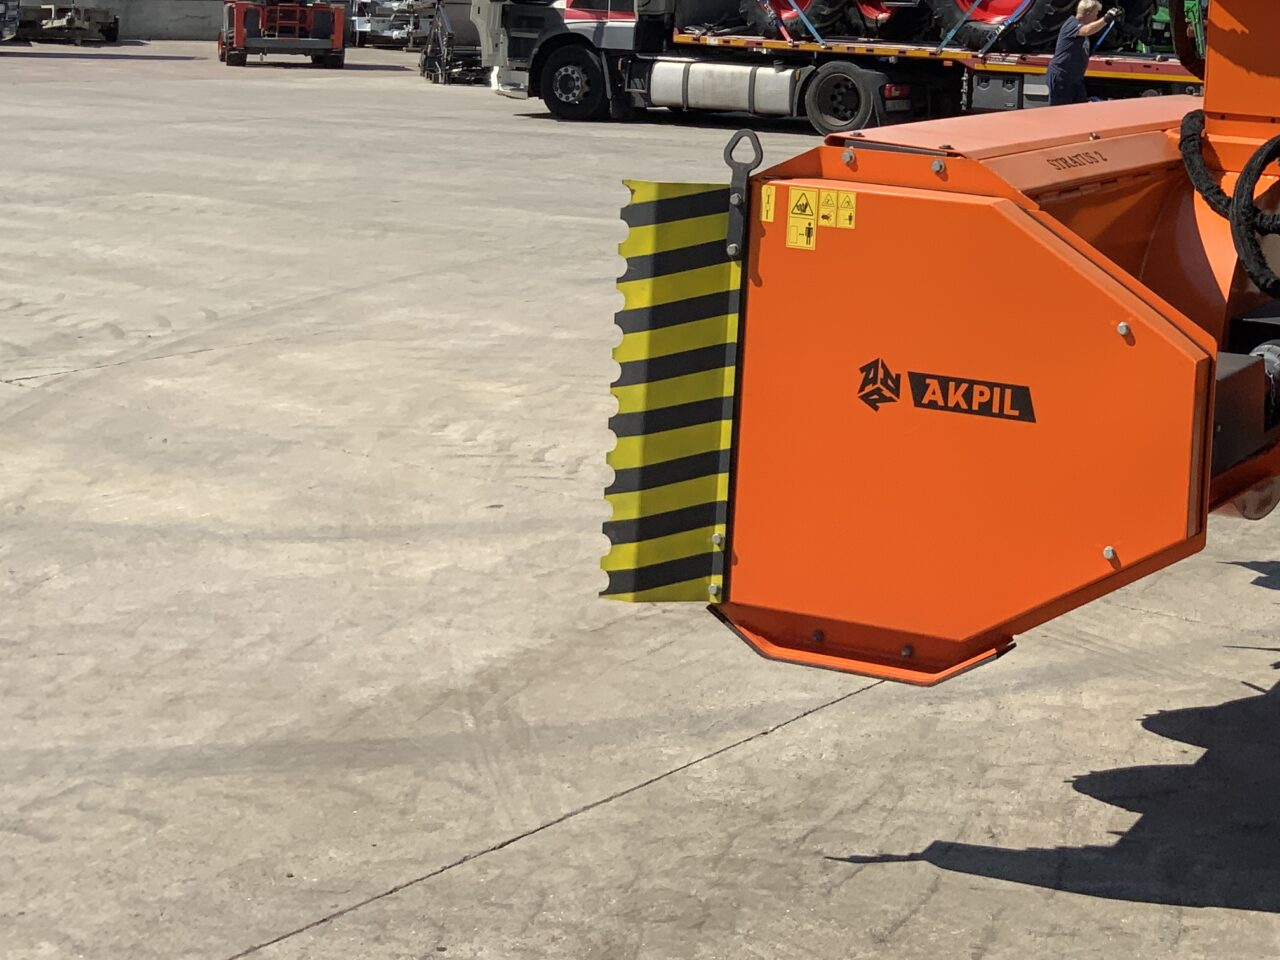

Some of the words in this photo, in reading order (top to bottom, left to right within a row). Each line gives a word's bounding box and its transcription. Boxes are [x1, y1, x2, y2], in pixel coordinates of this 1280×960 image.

[1046, 151, 1099, 170] STRATUS
[1094, 151, 1108, 162] 2
[920, 378, 1020, 416] AKPIL
